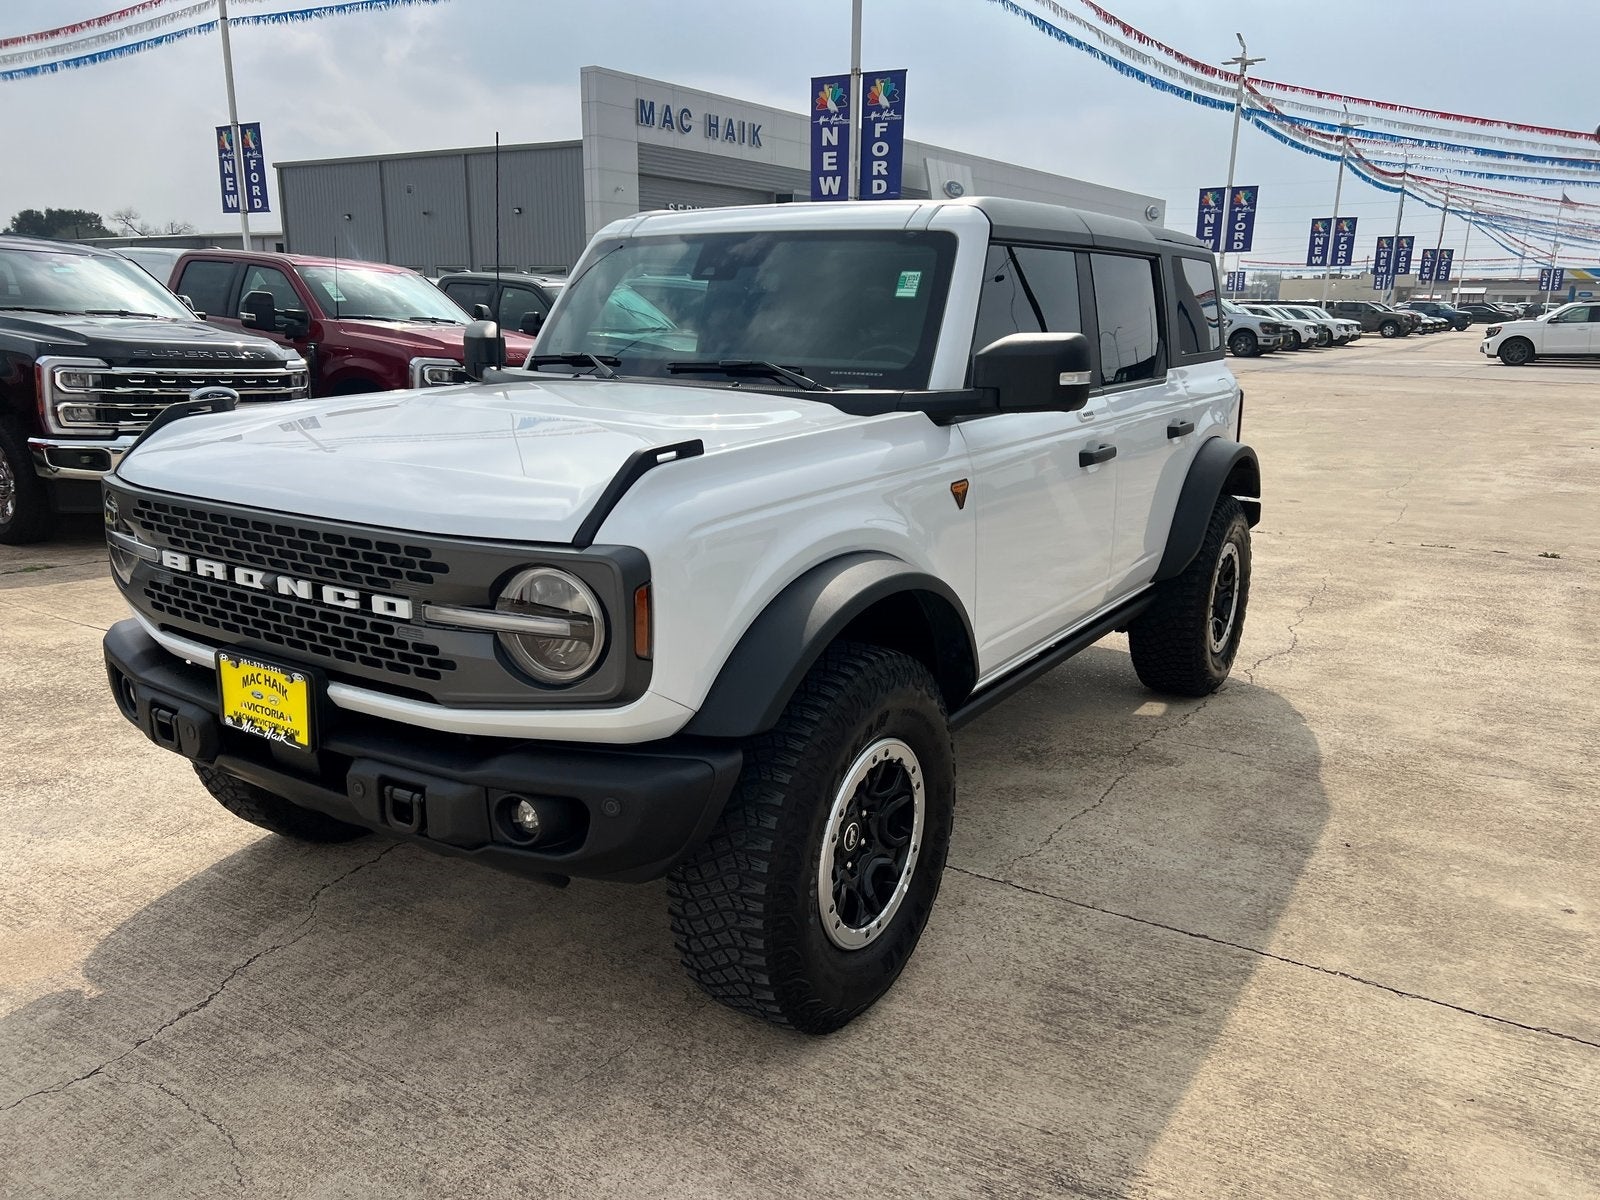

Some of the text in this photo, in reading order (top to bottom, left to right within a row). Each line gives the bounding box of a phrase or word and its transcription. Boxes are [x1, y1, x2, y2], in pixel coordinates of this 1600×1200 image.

[639, 98, 762, 147] MAC HAIK
[819, 126, 841, 195] NEW
[872, 122, 889, 195] FORD
[223, 160, 238, 208] NEW
[249, 159, 262, 209] FORD
[1201, 213, 1215, 249] NEW
[1233, 212, 1246, 250] FORD
[1312, 237, 1324, 264] NEW
[1337, 236, 1348, 264] FORD
[1377, 251, 1388, 273] NEW
[1398, 250, 1407, 273] FORD
[1422, 261, 1431, 279] NEW
[1439, 261, 1447, 279] FORD
[133, 349, 266, 359] SUPER DUTY
[162, 550, 413, 620] BRONCO
[242, 672, 288, 702] MAC HAIK
[246, 701, 286, 721] VICTORIA
[242, 719, 262, 733] Mac
